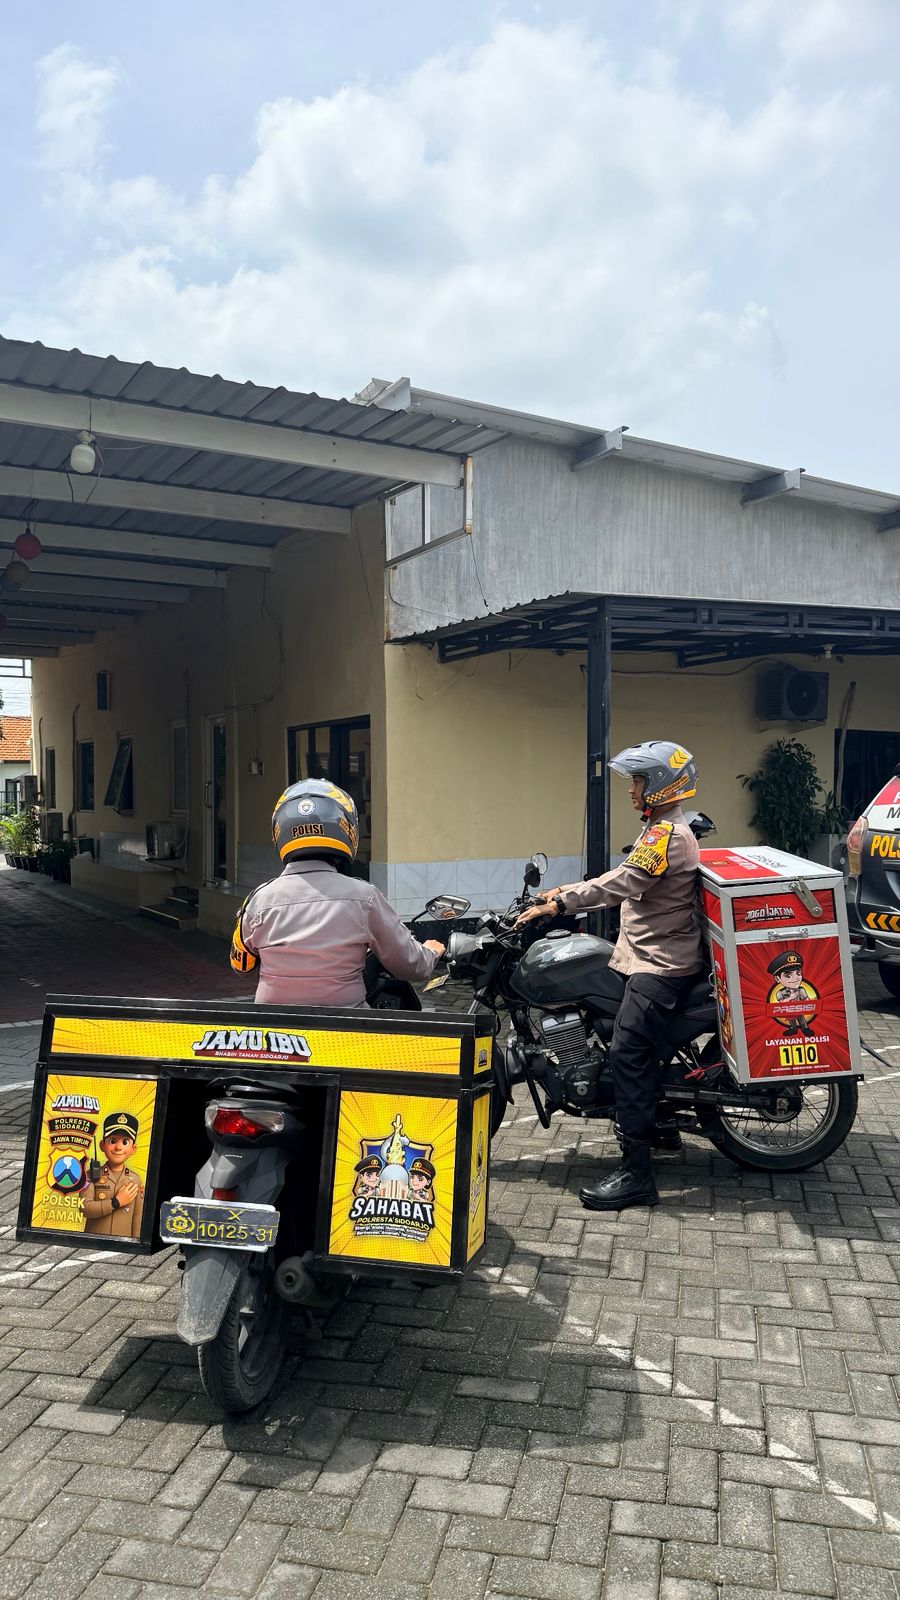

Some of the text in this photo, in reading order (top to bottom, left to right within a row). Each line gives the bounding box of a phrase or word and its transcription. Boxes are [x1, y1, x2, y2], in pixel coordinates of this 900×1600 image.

[292, 824, 324, 838] POLISI
[773, 1003, 816, 1014] PRESISI
[192, 1030, 312, 1057] JAMU IBU
[765, 1035, 830, 1047] LAYANAN POLISI
[782, 1046, 817, 1064] 110
[52, 1095, 81, 1108] JAMU
[82, 1096, 100, 1111] IBU
[54, 1118, 91, 1127] POLRESTA
[54, 1123, 89, 1132] SIDOARJO
[52, 1136, 90, 1147] JAWA TIMUR
[42, 1194, 86, 1209] POLSEK
[42, 1208, 84, 1223] TAMAN
[351, 1198, 433, 1225] SAHABAT
[394, 1217, 430, 1231] SIDOARJO
[199, 1223, 274, 1242] 10125-31
